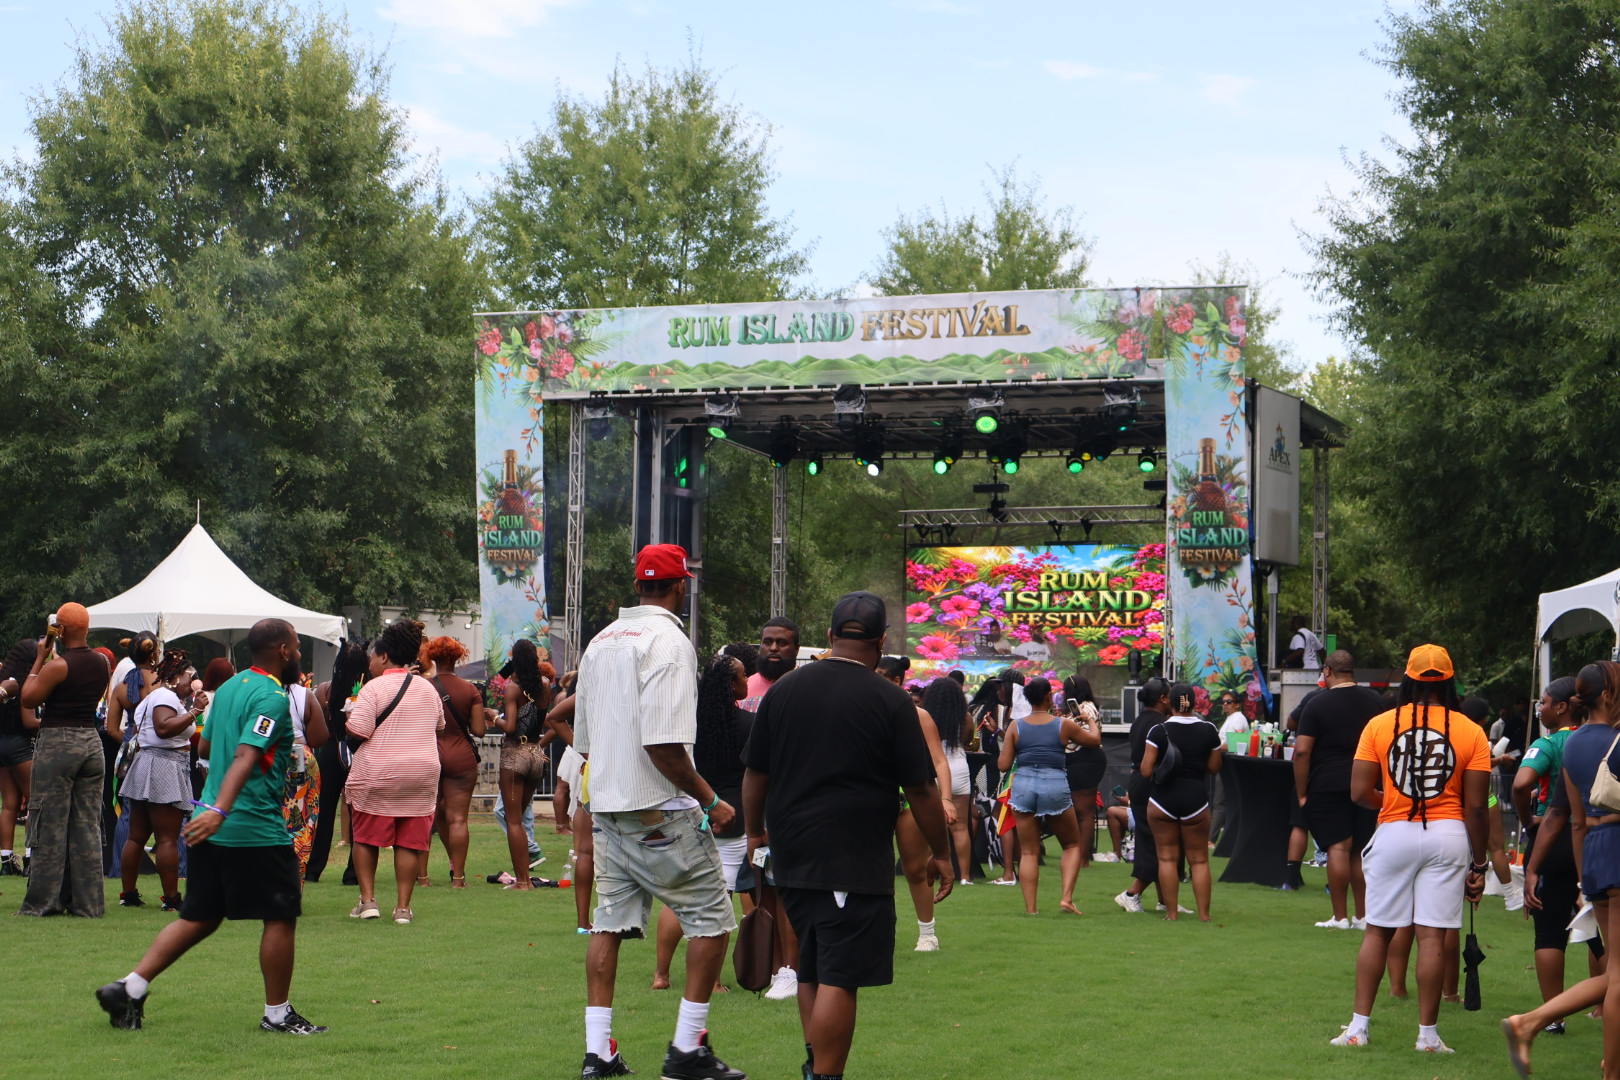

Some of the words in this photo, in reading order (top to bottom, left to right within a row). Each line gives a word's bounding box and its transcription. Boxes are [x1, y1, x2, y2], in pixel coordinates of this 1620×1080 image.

[668, 315, 731, 349] RUM
[737, 312, 855, 345] ISLAND
[861, 300, 1031, 341] FESTIVAL
[498, 515, 524, 529] RUM
[1193, 511, 1224, 526] RUM
[484, 530, 542, 547] ISLAND
[1176, 528, 1247, 546] ISLAND
[487, 548, 538, 561] FESTIVAL
[1180, 547, 1242, 561] FESTIVAL
[1040, 572, 1108, 591] RUM
[1004, 590, 1152, 611] ISLAND
[1012, 610, 1143, 626] FESTIVAL
